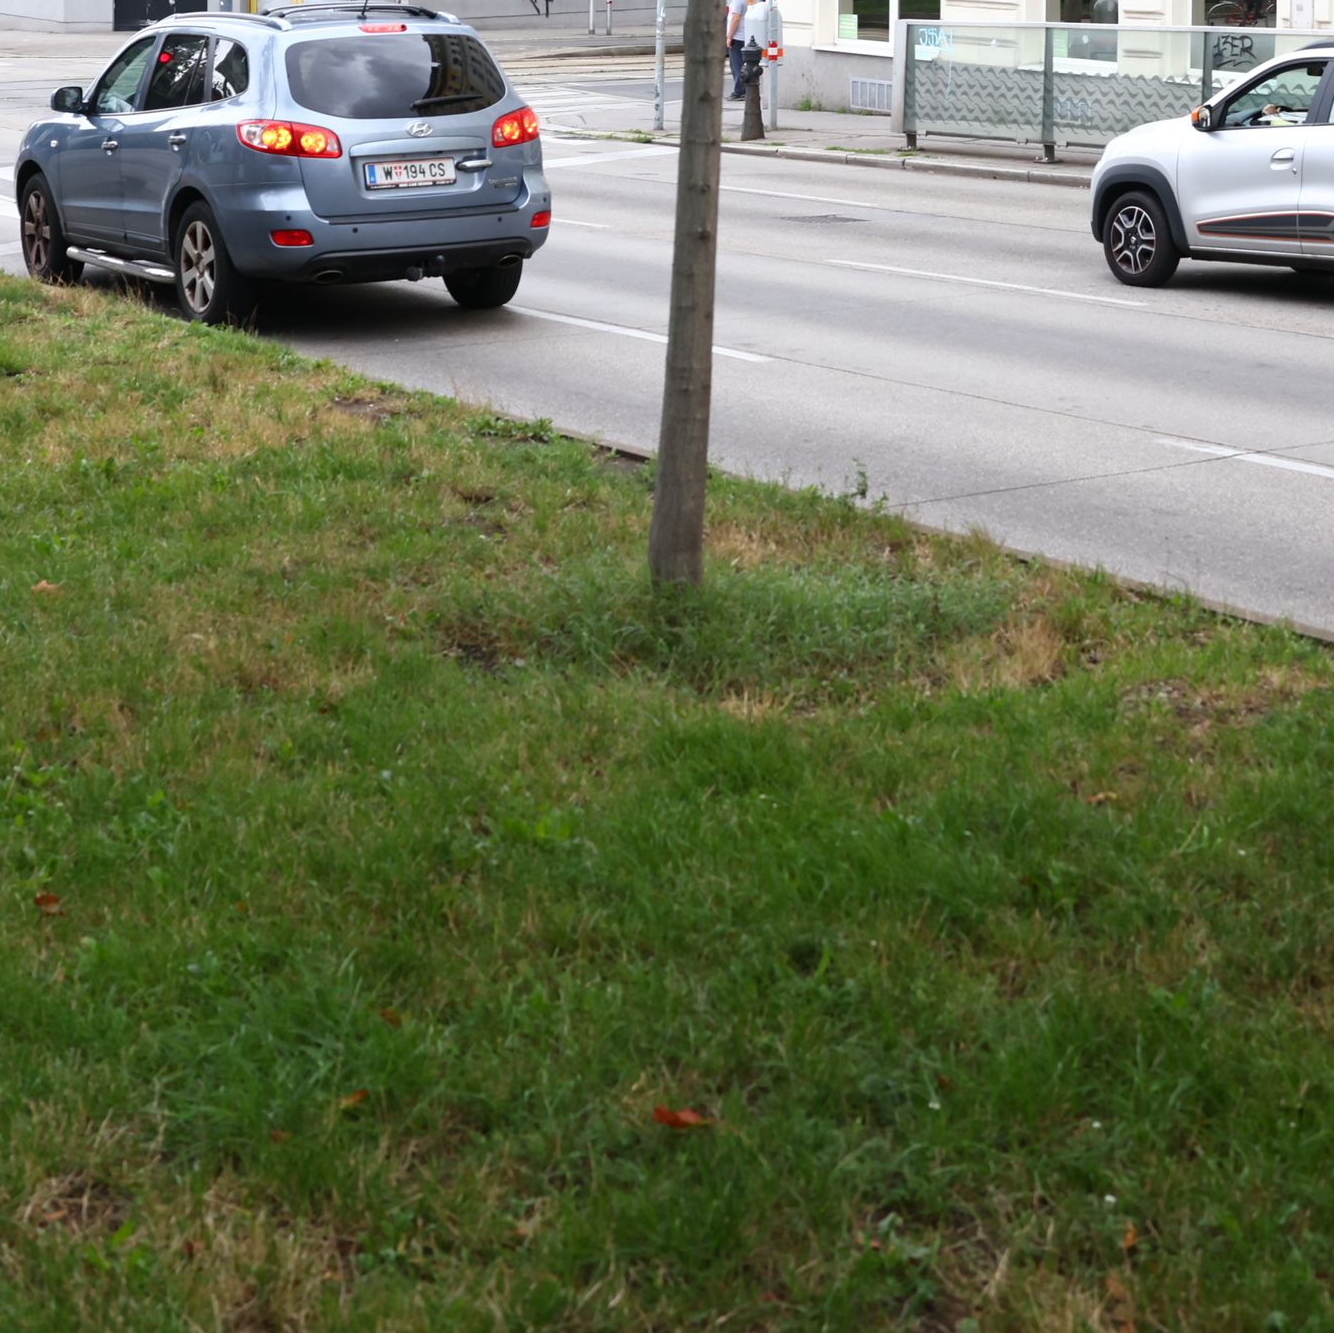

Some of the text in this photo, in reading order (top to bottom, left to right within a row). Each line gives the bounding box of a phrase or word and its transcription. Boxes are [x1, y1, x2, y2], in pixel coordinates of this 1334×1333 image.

[383, 163, 445, 180] W 194 CS
